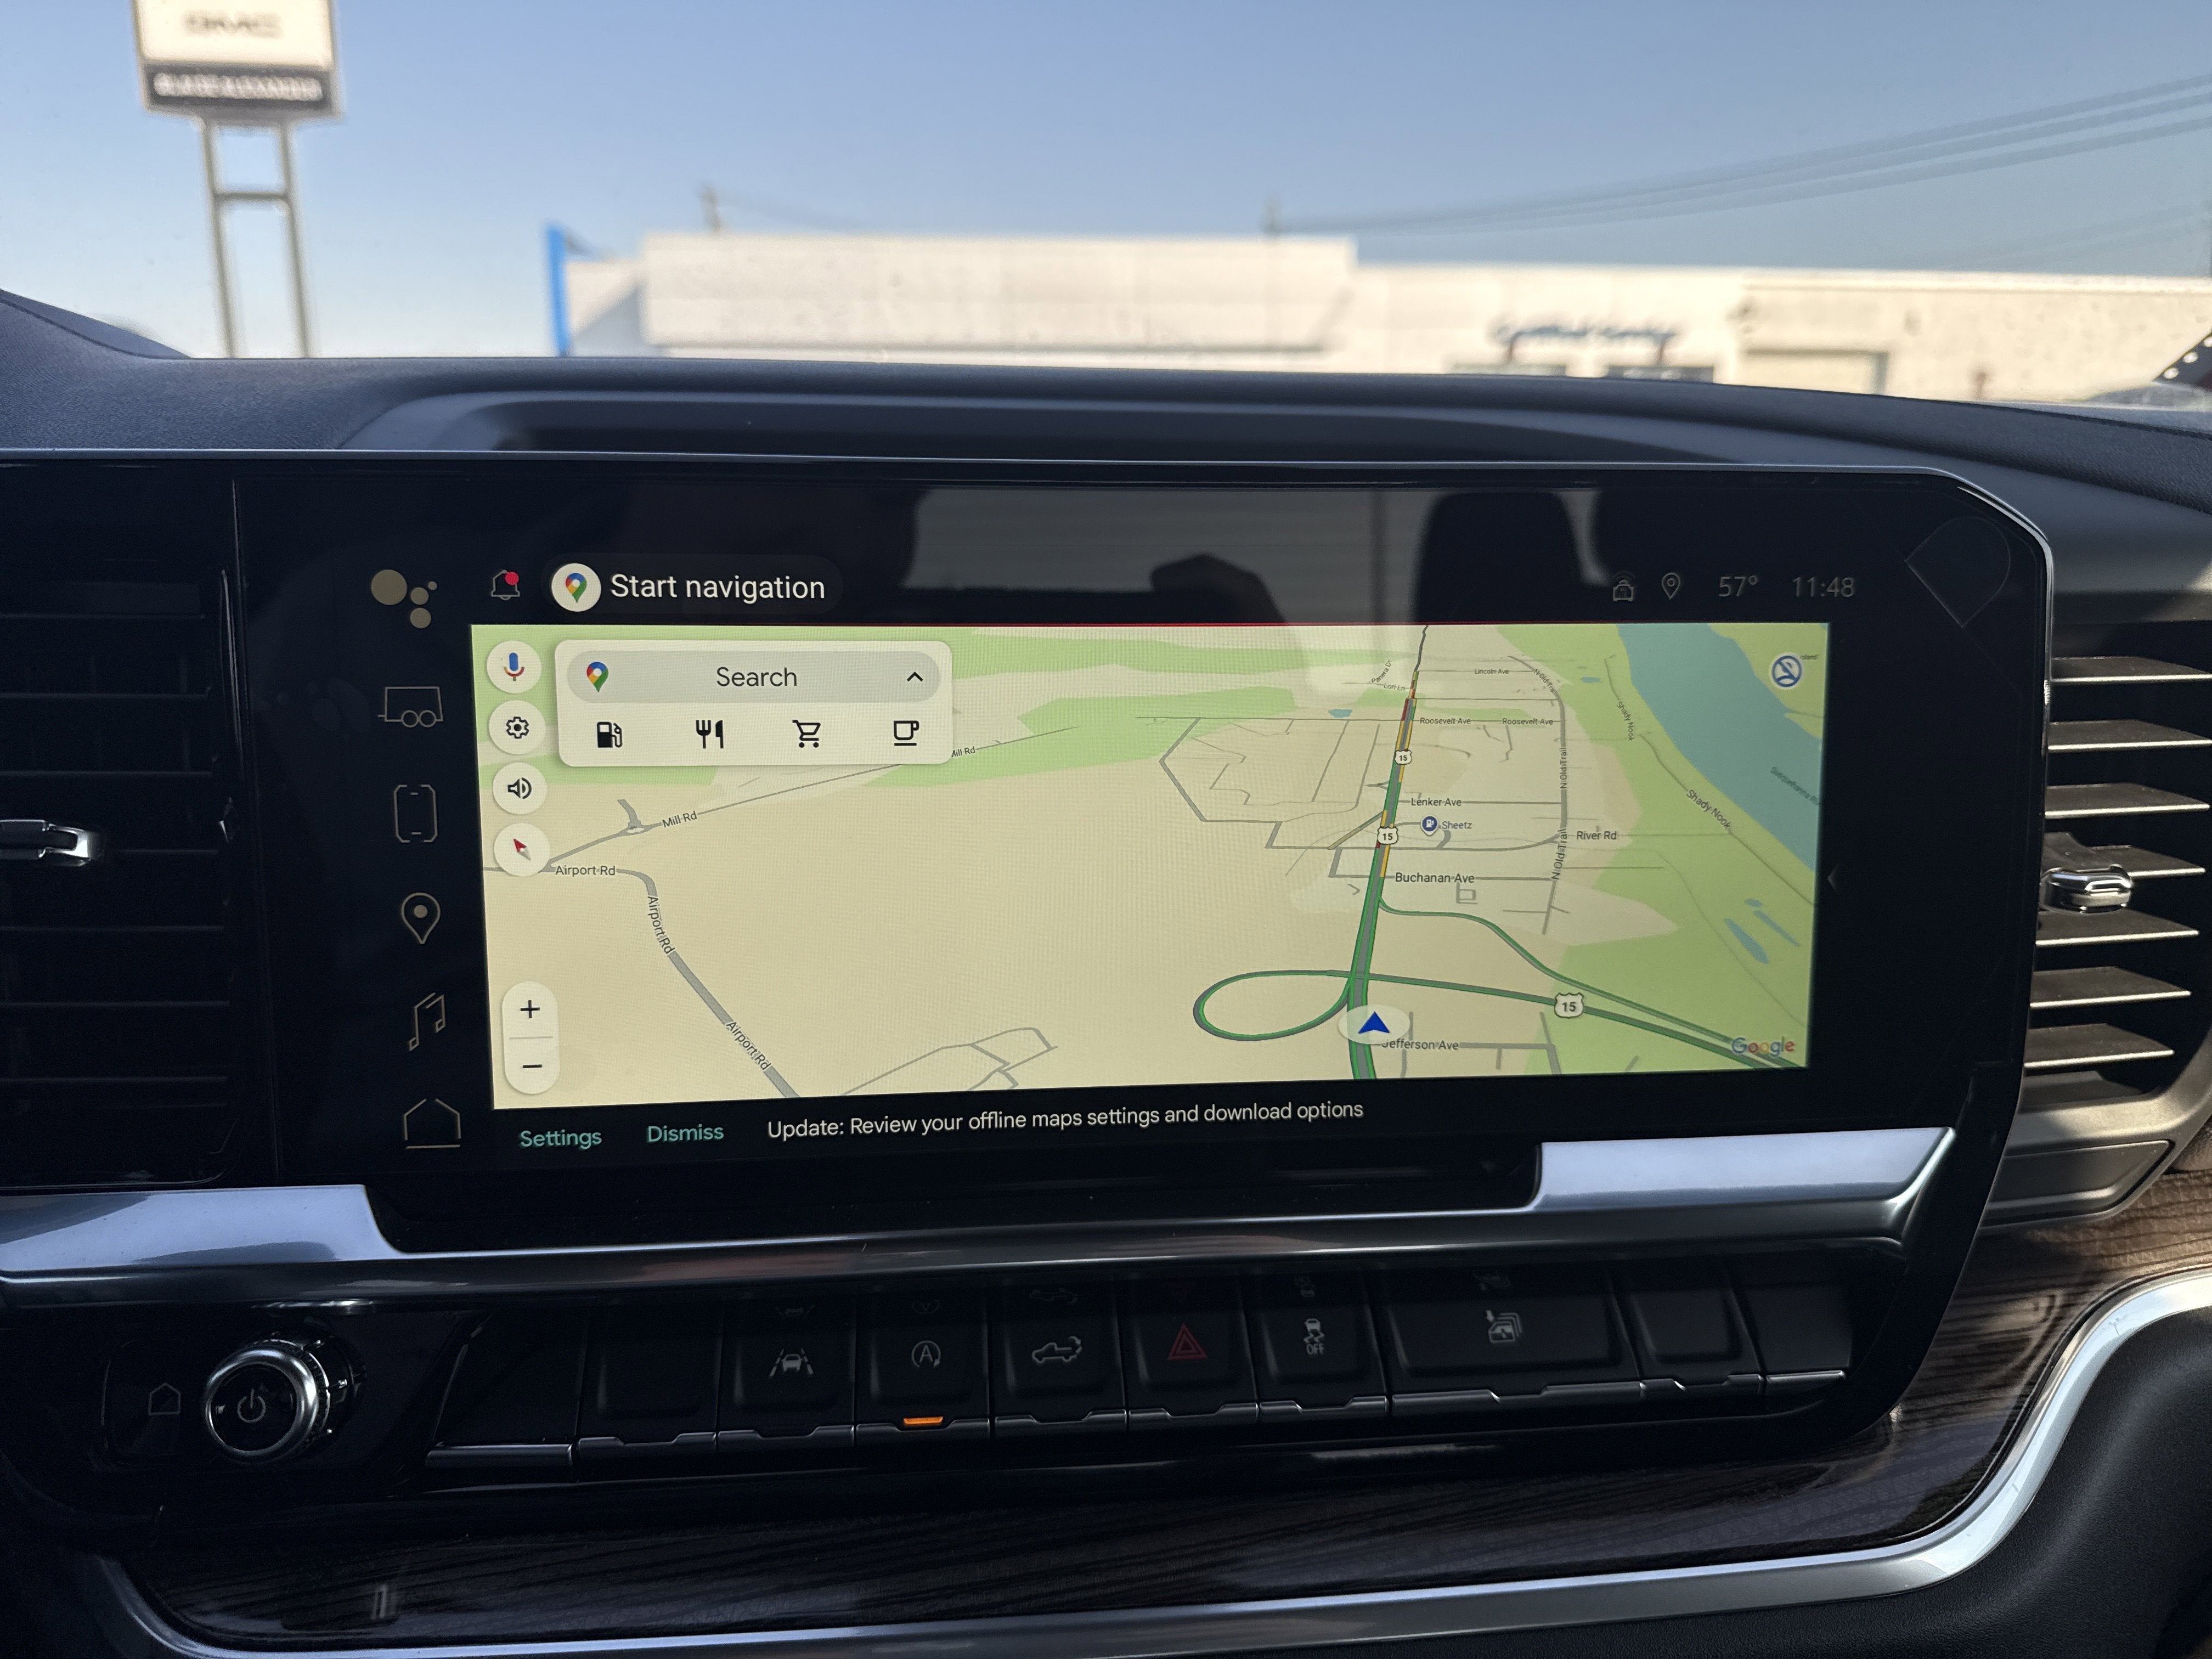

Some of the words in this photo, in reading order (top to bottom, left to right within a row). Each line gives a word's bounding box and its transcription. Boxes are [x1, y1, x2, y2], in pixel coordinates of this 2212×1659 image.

[611, 574, 677, 598] Start
[685, 575, 826, 605] navigation
[1718, 575, 1758, 597] 57°
[1793, 577, 1855, 597] 11:48
[716, 667, 798, 687] Search
[1539, 673, 1549, 683] Old
[1546, 682, 1558, 695] Trail
[1616, 701, 1631, 721] Shady
[964, 746, 975, 755] Rd
[1411, 798, 1442, 806] Lenker
[1444, 798, 1462, 806] Ave
[1686, 789, 1712, 812] Shady
[1711, 808, 1731, 830] Nook
[662, 815, 681, 828] Mill
[683, 811, 697, 822] Rd
[1442, 821, 1472, 830] Sheetz
[1557, 828, 1567, 850] Trail
[1576, 831, 1601, 840] River
[1604, 831, 1617, 840] Rd
[1554, 852, 1565, 869] Old
[555, 865, 596, 877] Airport
[600, 865, 616, 876] Rd
[1396, 872, 1451, 883] Buchanan
[1454, 873, 1475, 883] Ave
[1551, 872, 1560, 880] N
[647, 896, 666, 937] Airport
[659, 937, 676, 954] Rd
[1561, 1001, 1576, 1013] 15
[726, 1022, 758, 1056] Airport
[754, 1053, 771, 1070] Rd
[1438, 1040, 1459, 1050] Ave
[1730, 1037, 1795, 1057] Google
[768, 1119, 844, 1141] Update:
[850, 1115, 917, 1135] Review
[921, 1115, 963, 1135] your
[968, 1110, 1027, 1130] offline
[1032, 1111, 1082, 1131] maps
[1087, 1107, 1160, 1128] settings
[1164, 1104, 1199, 1123] and
[1204, 1101, 1292, 1122] download
[1296, 1101, 1364, 1122] options
[520, 1128, 602, 1150] Settings
[647, 1123, 724, 1143] Dismiss
[1306, 1343, 1325, 1355] OFF
